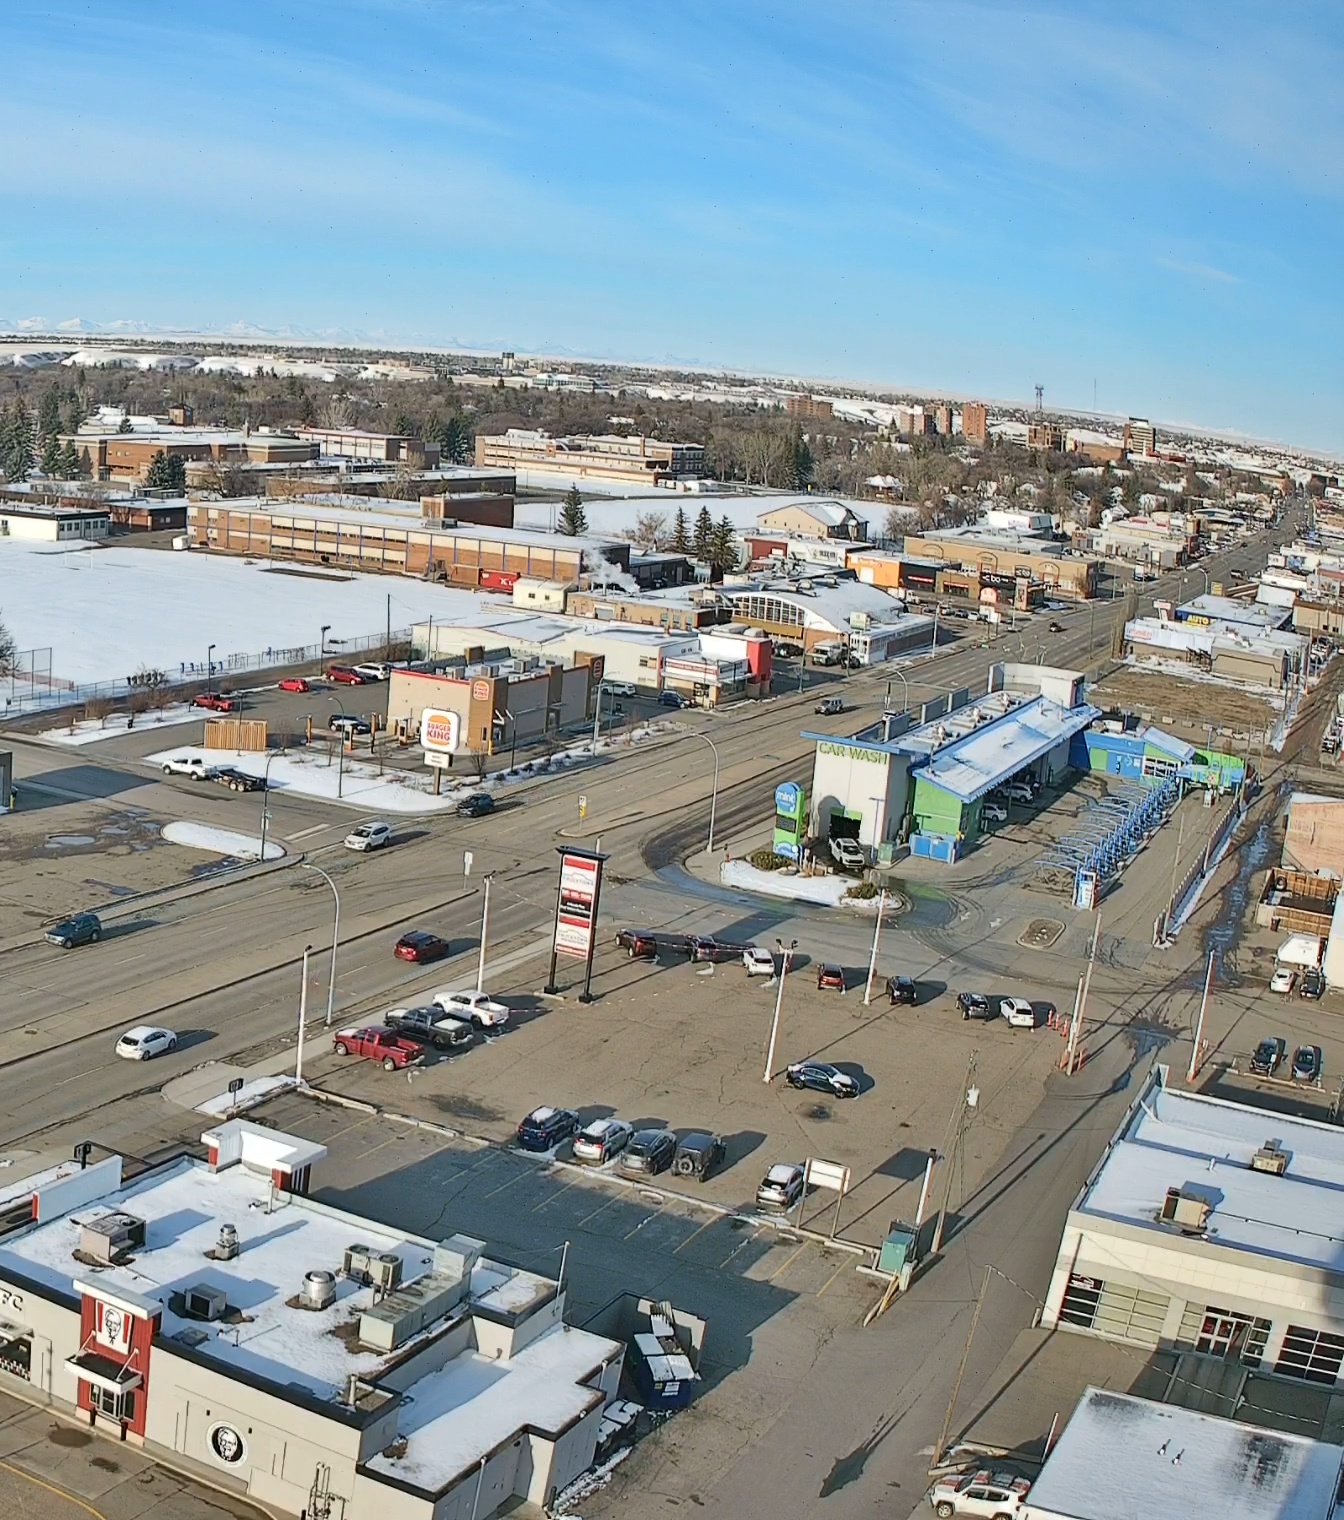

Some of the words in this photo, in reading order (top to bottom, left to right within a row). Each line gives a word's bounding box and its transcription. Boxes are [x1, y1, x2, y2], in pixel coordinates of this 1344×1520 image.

[1187, 615, 1209, 625] AUTO
[427, 722, 451, 732] BURGER
[427, 730, 450, 741] KING
[819, 743, 846, 758] CAR
[849, 747, 888, 765] WASH
[777, 791, 794, 802] mint
